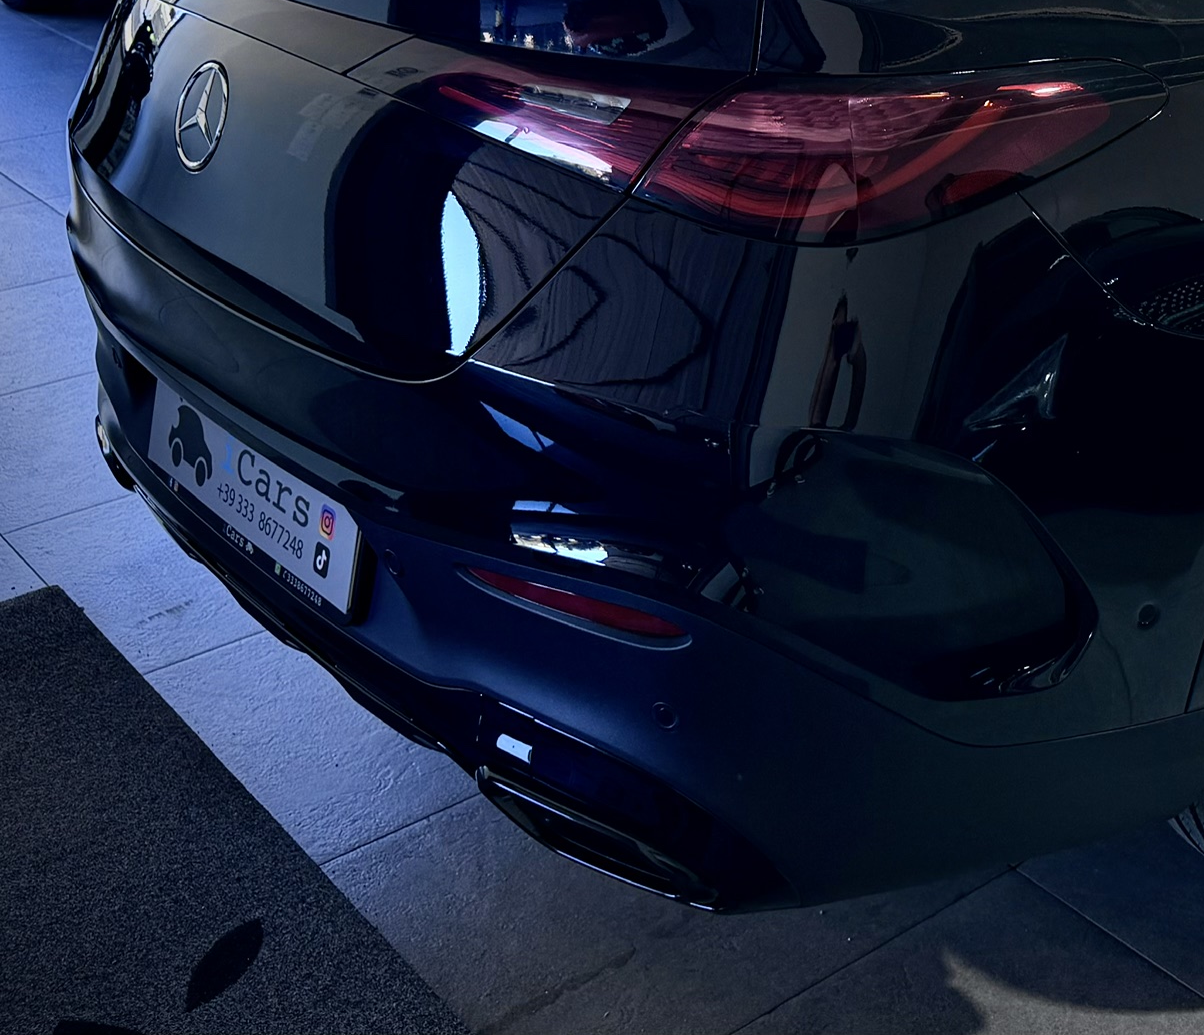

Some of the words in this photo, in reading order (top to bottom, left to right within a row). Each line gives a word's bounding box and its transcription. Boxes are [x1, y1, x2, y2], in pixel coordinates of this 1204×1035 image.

[216, 482, 236, 507] +39
[235, 494, 255, 523] 333
[258, 511, 304, 560] 8677248
